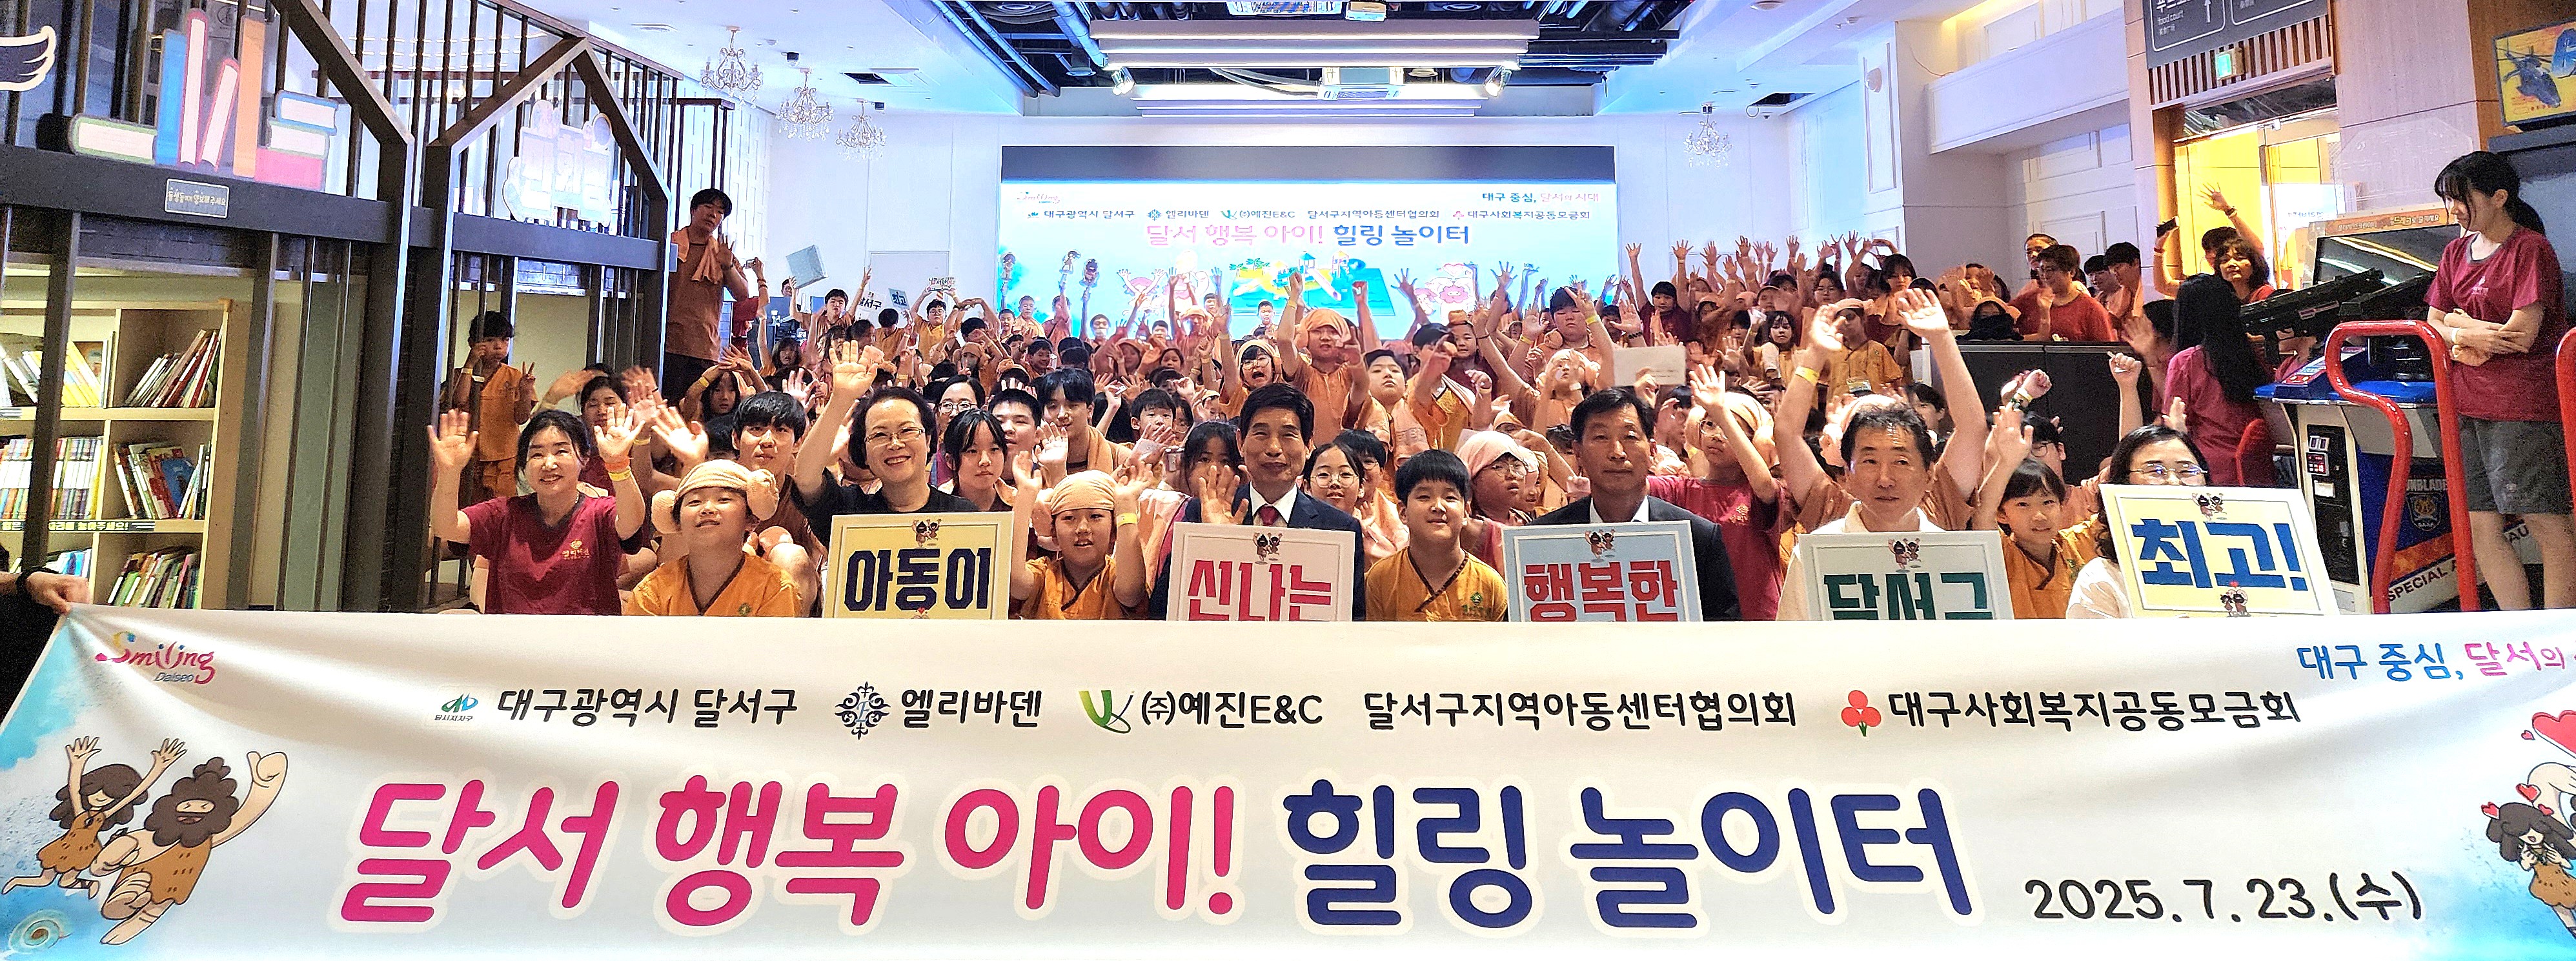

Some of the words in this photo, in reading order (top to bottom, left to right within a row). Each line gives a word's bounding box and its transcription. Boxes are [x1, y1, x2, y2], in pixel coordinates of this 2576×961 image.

[1044, 210, 1099, 219] 대구광역시
[1102, 210, 1135, 219] 달서구
[1166, 210, 1209, 219] 엘리바덴
[1308, 210, 1439, 219] 달서구지역아동센터협의회
[1467, 210, 1590, 219] 대구사회복지공동모금회
[1483, 193, 1505, 201] 대구
[1510, 192, 1536, 203] 중심,
[1147, 226, 1196, 246] 달서
[1205, 225, 1257, 246] 행복
[1264, 226, 1323, 245] 아이!
[1333, 225, 1383, 246] 힐링
[1390, 225, 1469, 246] 놀이터
[892, 291, 908, 307] 최고
[2131, 518, 2308, 591] 최고!
[844, 547, 991, 611] 아동이
[1188, 560, 1338, 622] 신나는
[1524, 560, 1678, 622] 행복한
[2388, 567, 2448, 602] SPECIAL
[95, 631, 216, 685] Smiling
[2297, 645, 2368, 680] 대구
[2378, 643, 2464, 682] 중심,
[2464, 642, 2565, 676] 달서의
[497, 688, 679, 727] 대구광역시
[694, 688, 798, 728] 달서구
[901, 689, 1042, 729] 엘리바덴
[1141, 691, 1323, 729] (주)예진E&C
[1364, 691, 1796, 731] 달서구지역아동센터협의회
[1888, 691, 2302, 733] 대구사회복지공동모금회
[341, 779, 620, 922] 달서
[655, 774, 904, 927] 행복
[944, 785, 1234, 915] 아이!
[1283, 779, 1532, 927] 힐링
[1570, 787, 1973, 928] 놀이터
